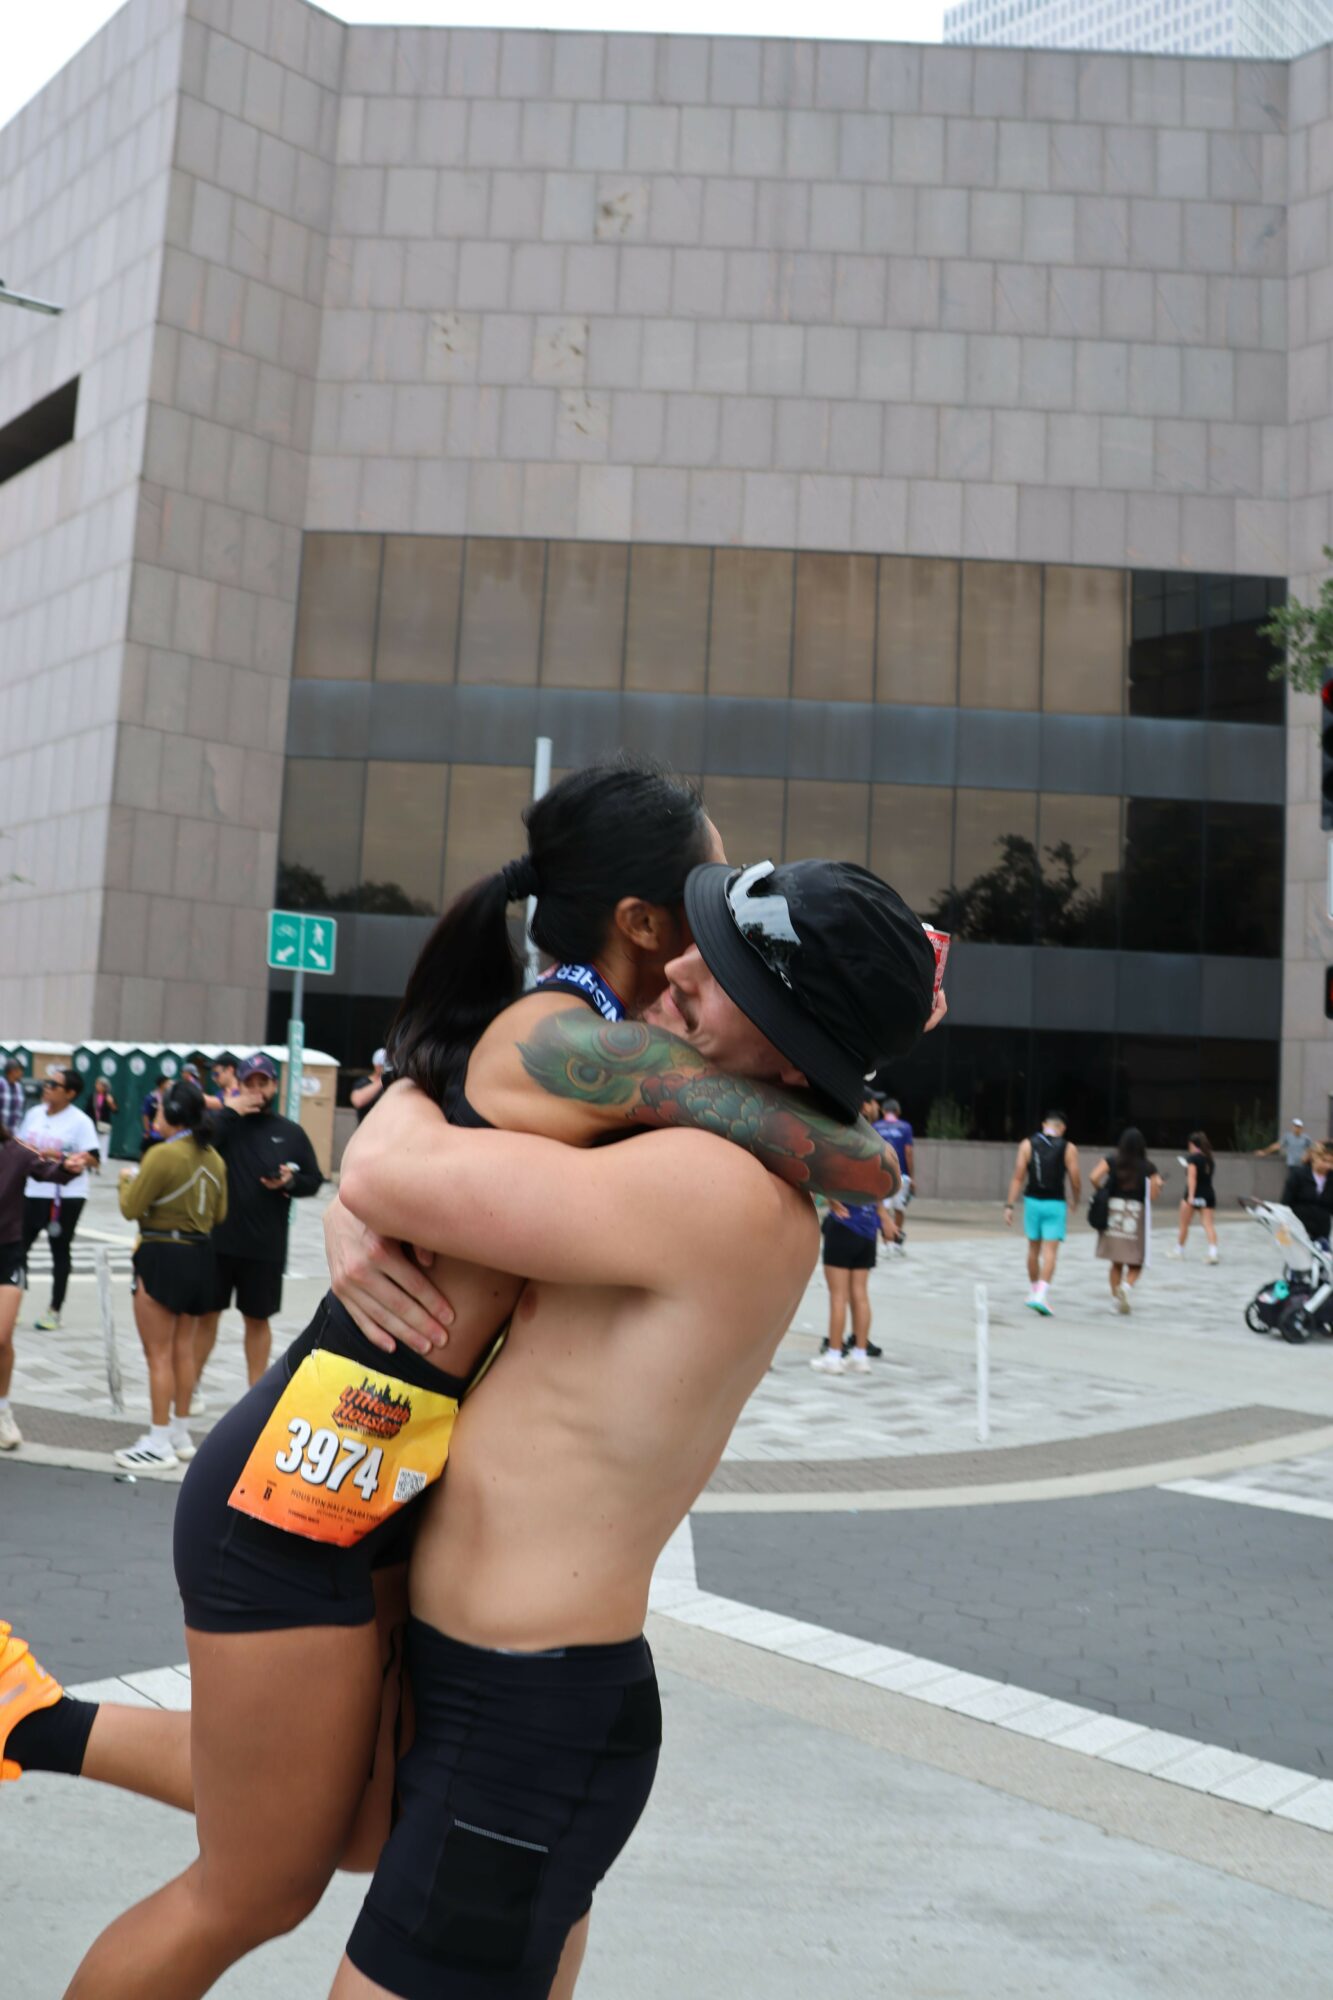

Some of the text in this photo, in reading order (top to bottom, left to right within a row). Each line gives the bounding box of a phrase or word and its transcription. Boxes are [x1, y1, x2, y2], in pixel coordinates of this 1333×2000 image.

[275, 1417, 383, 1501] 3974
[291, 1488, 325, 1509] HOUSTON
[326, 1501, 346, 1513] HALF
